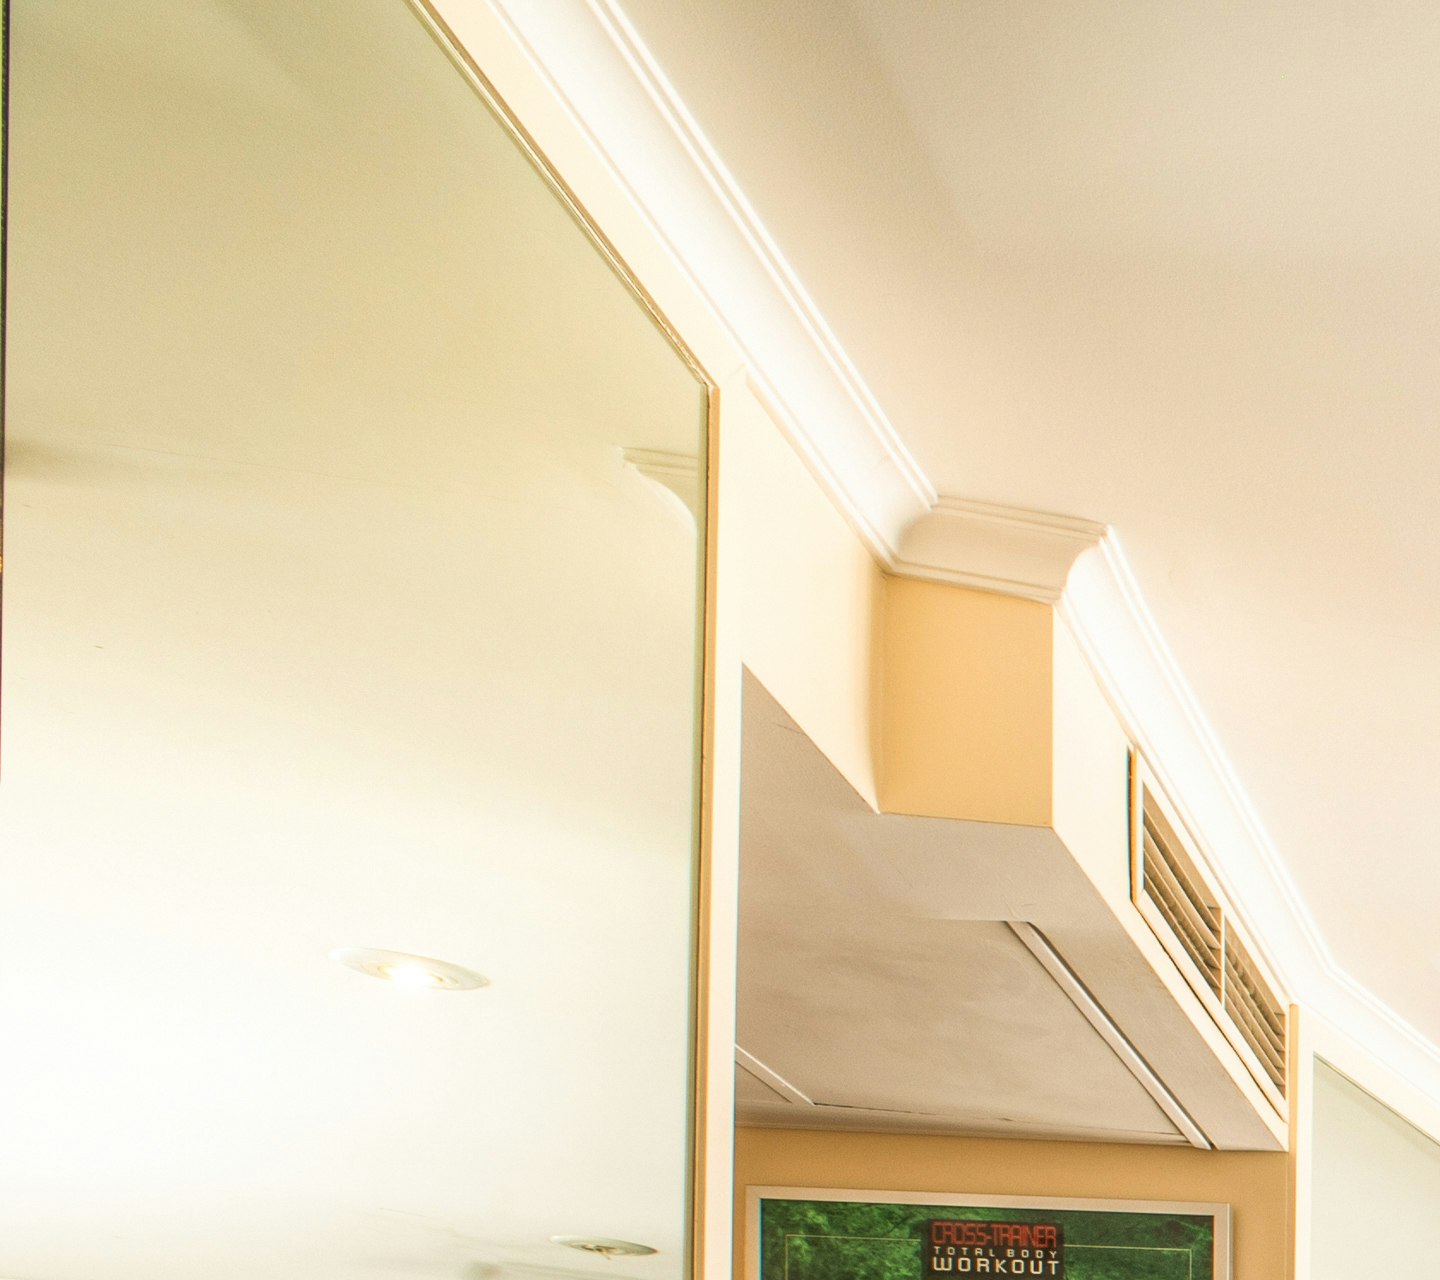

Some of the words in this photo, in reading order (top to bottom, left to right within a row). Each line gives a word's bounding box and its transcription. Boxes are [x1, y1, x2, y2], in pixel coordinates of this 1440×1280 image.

[932, 1221, 1057, 1248] CROSS-TRAINER
[934, 1246, 996, 1257] TOTAL
[1006, 1249, 1057, 1259] BODY
[932, 1256, 1060, 1275] WORKOUT
